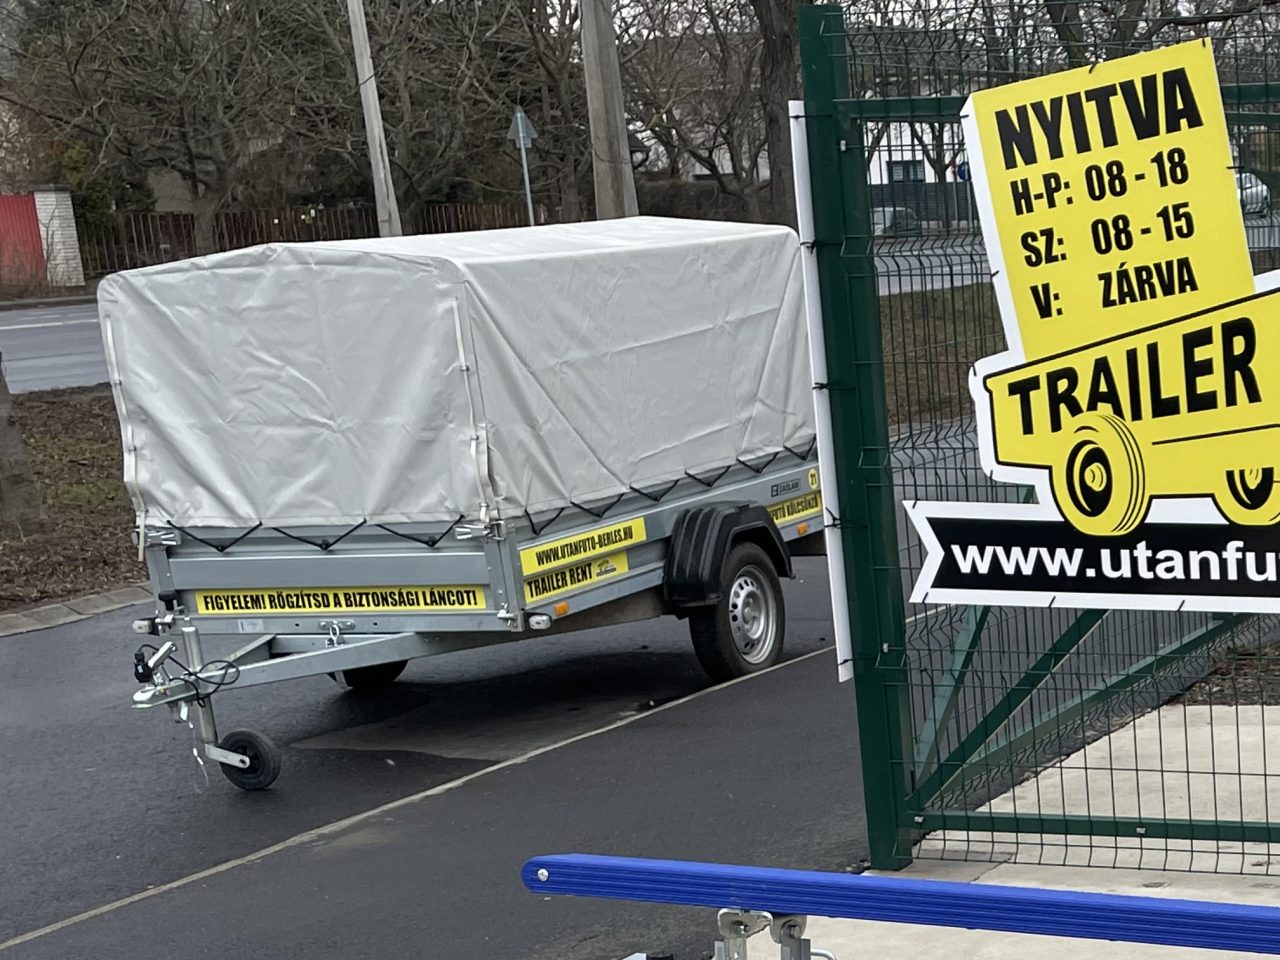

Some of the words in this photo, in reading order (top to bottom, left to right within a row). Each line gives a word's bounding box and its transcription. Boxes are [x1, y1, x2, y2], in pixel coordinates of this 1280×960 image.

[994, 67, 1204, 170] NYITVA
[1010, 172, 1073, 216] H-P:
[1084, 159, 1128, 202] 08
[1151, 147, 1190, 188] 18
[1020, 228, 1067, 268] SZ:
[1091, 213, 1134, 255] 08
[1156, 202, 1195, 242] 15
[1030, 282, 1064, 319] V:
[1098, 257, 1199, 308] ZÁRVA
[1007, 317, 1263, 436] TRAILER
[535, 525, 634, 567] WWW.UTANFUTO-BERLES.HU
[203, 594, 267, 610] FIGYELEM!
[267, 590, 330, 609] RÖGZÍTSD
[332, 592, 343, 608] A
[343, 588, 421, 608] BIZTONSÁGI
[422, 588, 478, 606] LÁNCOT!
[527, 571, 568, 598] TRAILER
[568, 562, 593, 586] RENT
